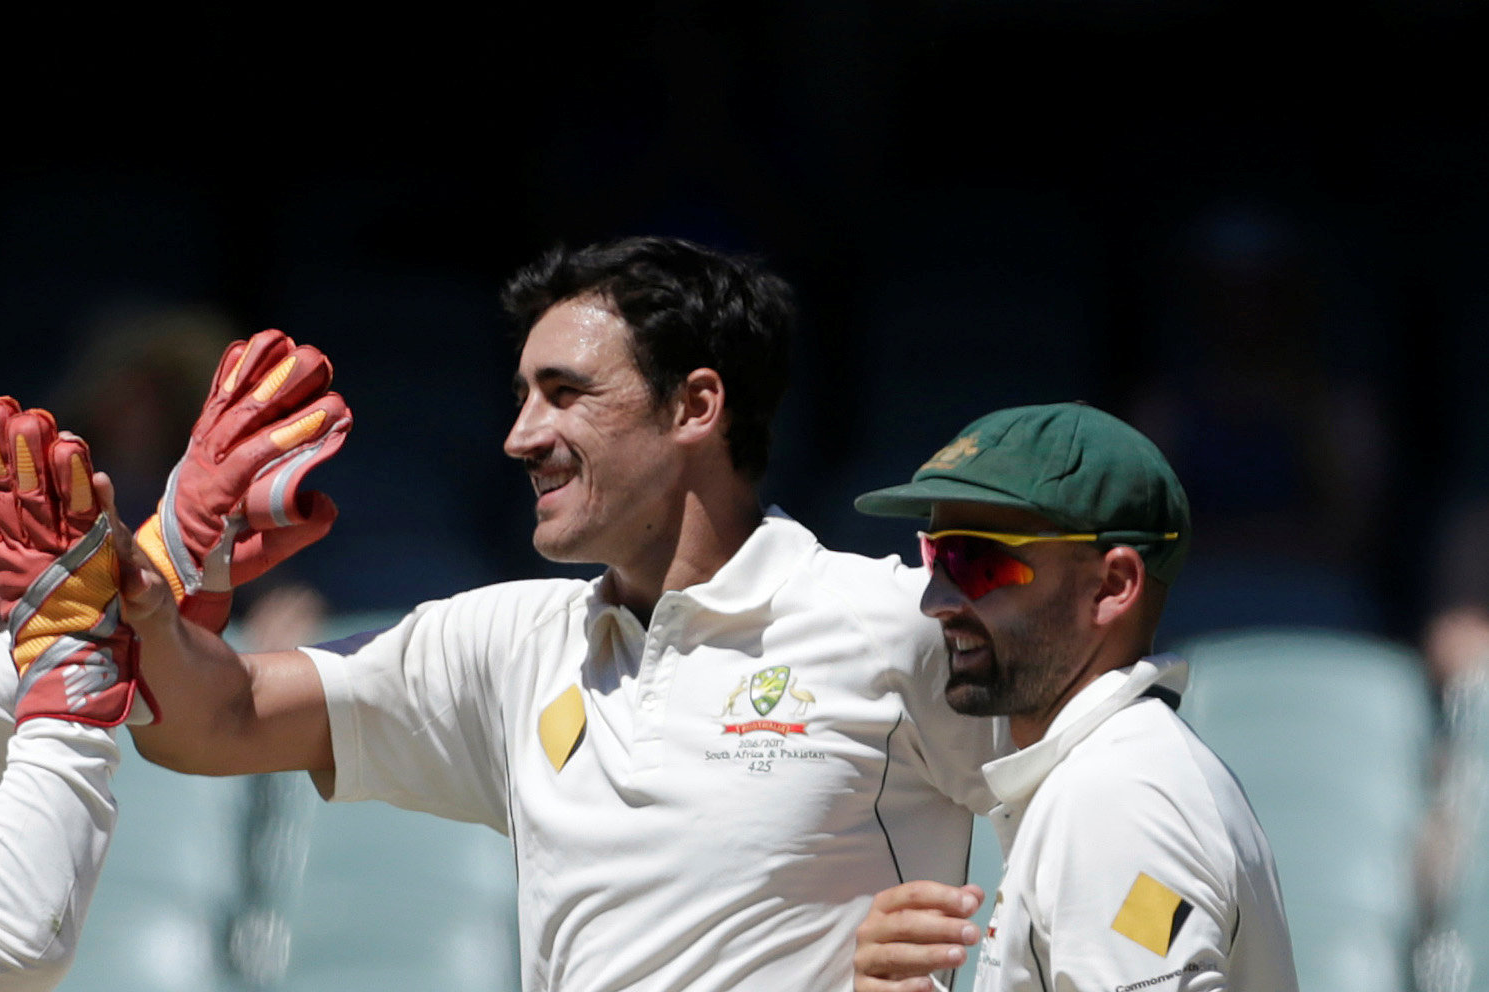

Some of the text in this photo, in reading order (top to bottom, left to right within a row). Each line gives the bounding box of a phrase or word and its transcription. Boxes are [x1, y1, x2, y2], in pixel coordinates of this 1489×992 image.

[705, 748, 826, 761] South Africa & Pakistan
[748, 760, 773, 773] 425
